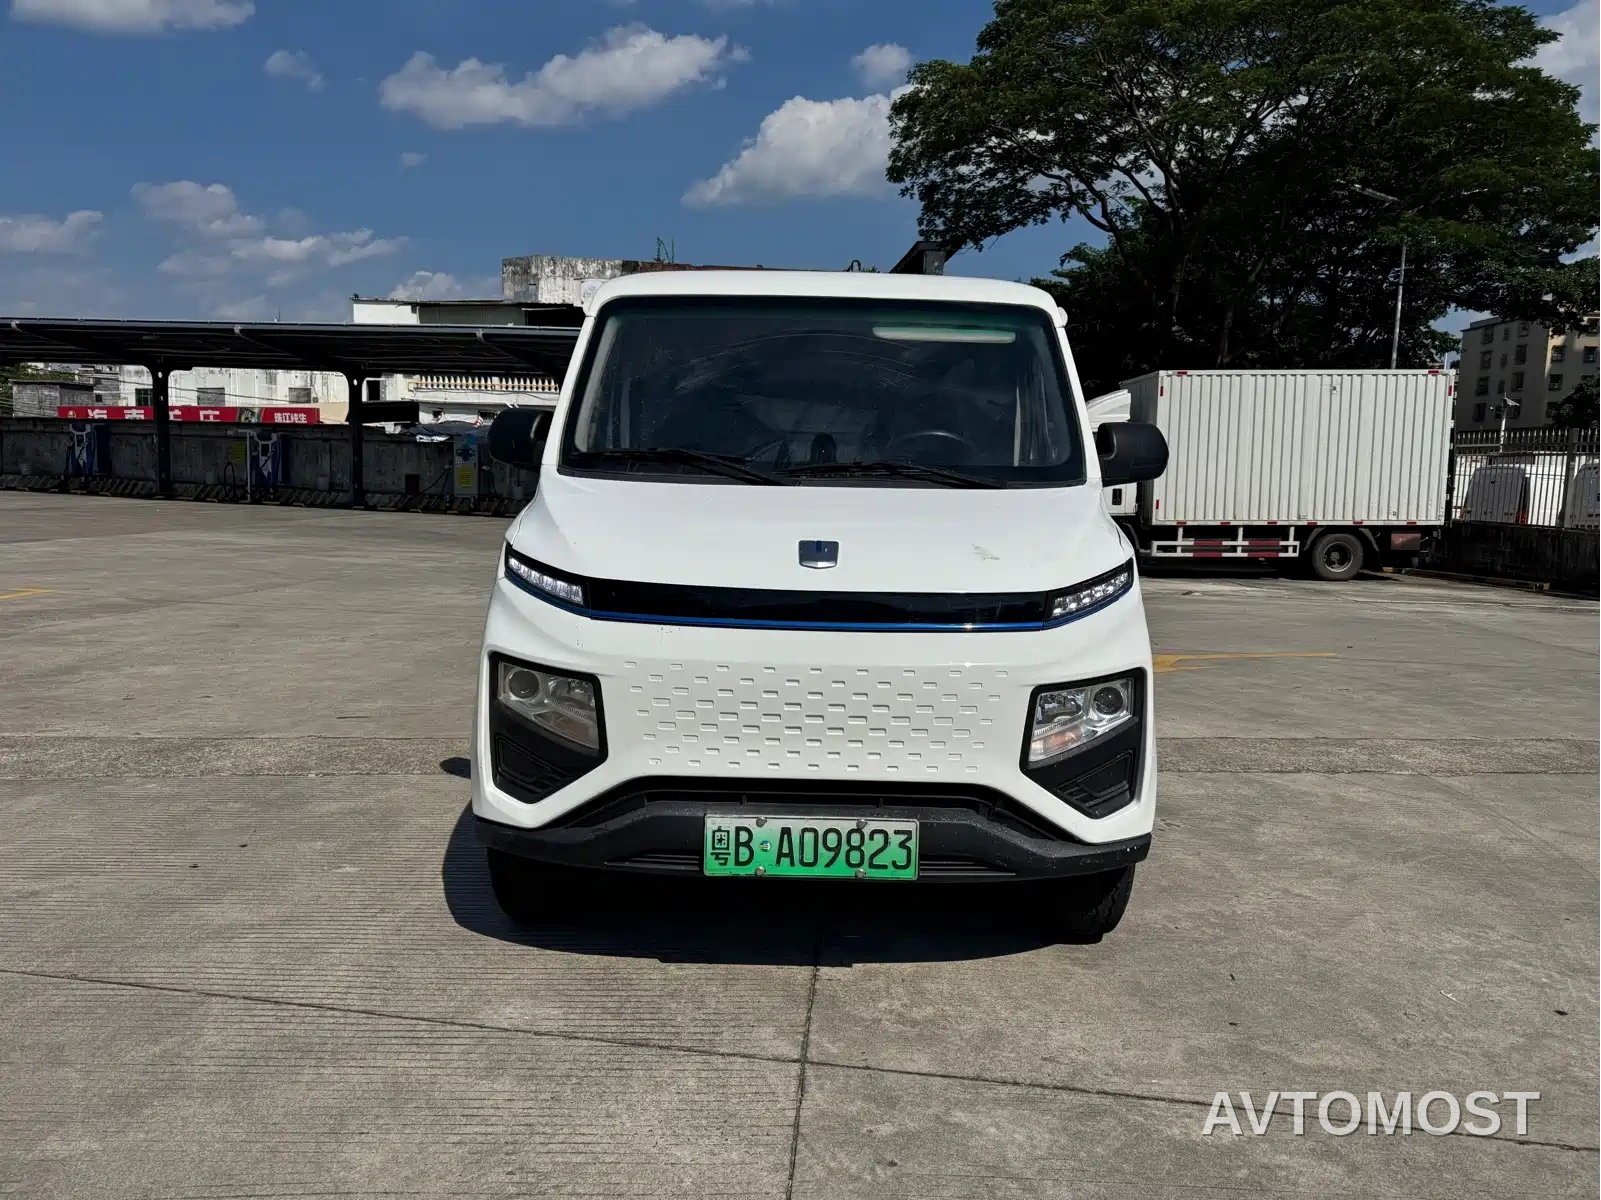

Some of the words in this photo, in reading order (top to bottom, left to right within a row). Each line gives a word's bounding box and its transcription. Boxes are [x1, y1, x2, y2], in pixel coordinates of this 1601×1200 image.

[273, 411, 308, 424] 珠江纯生
[710, 825, 755, 867] 粤B
[775, 826, 914, 870] A09823
